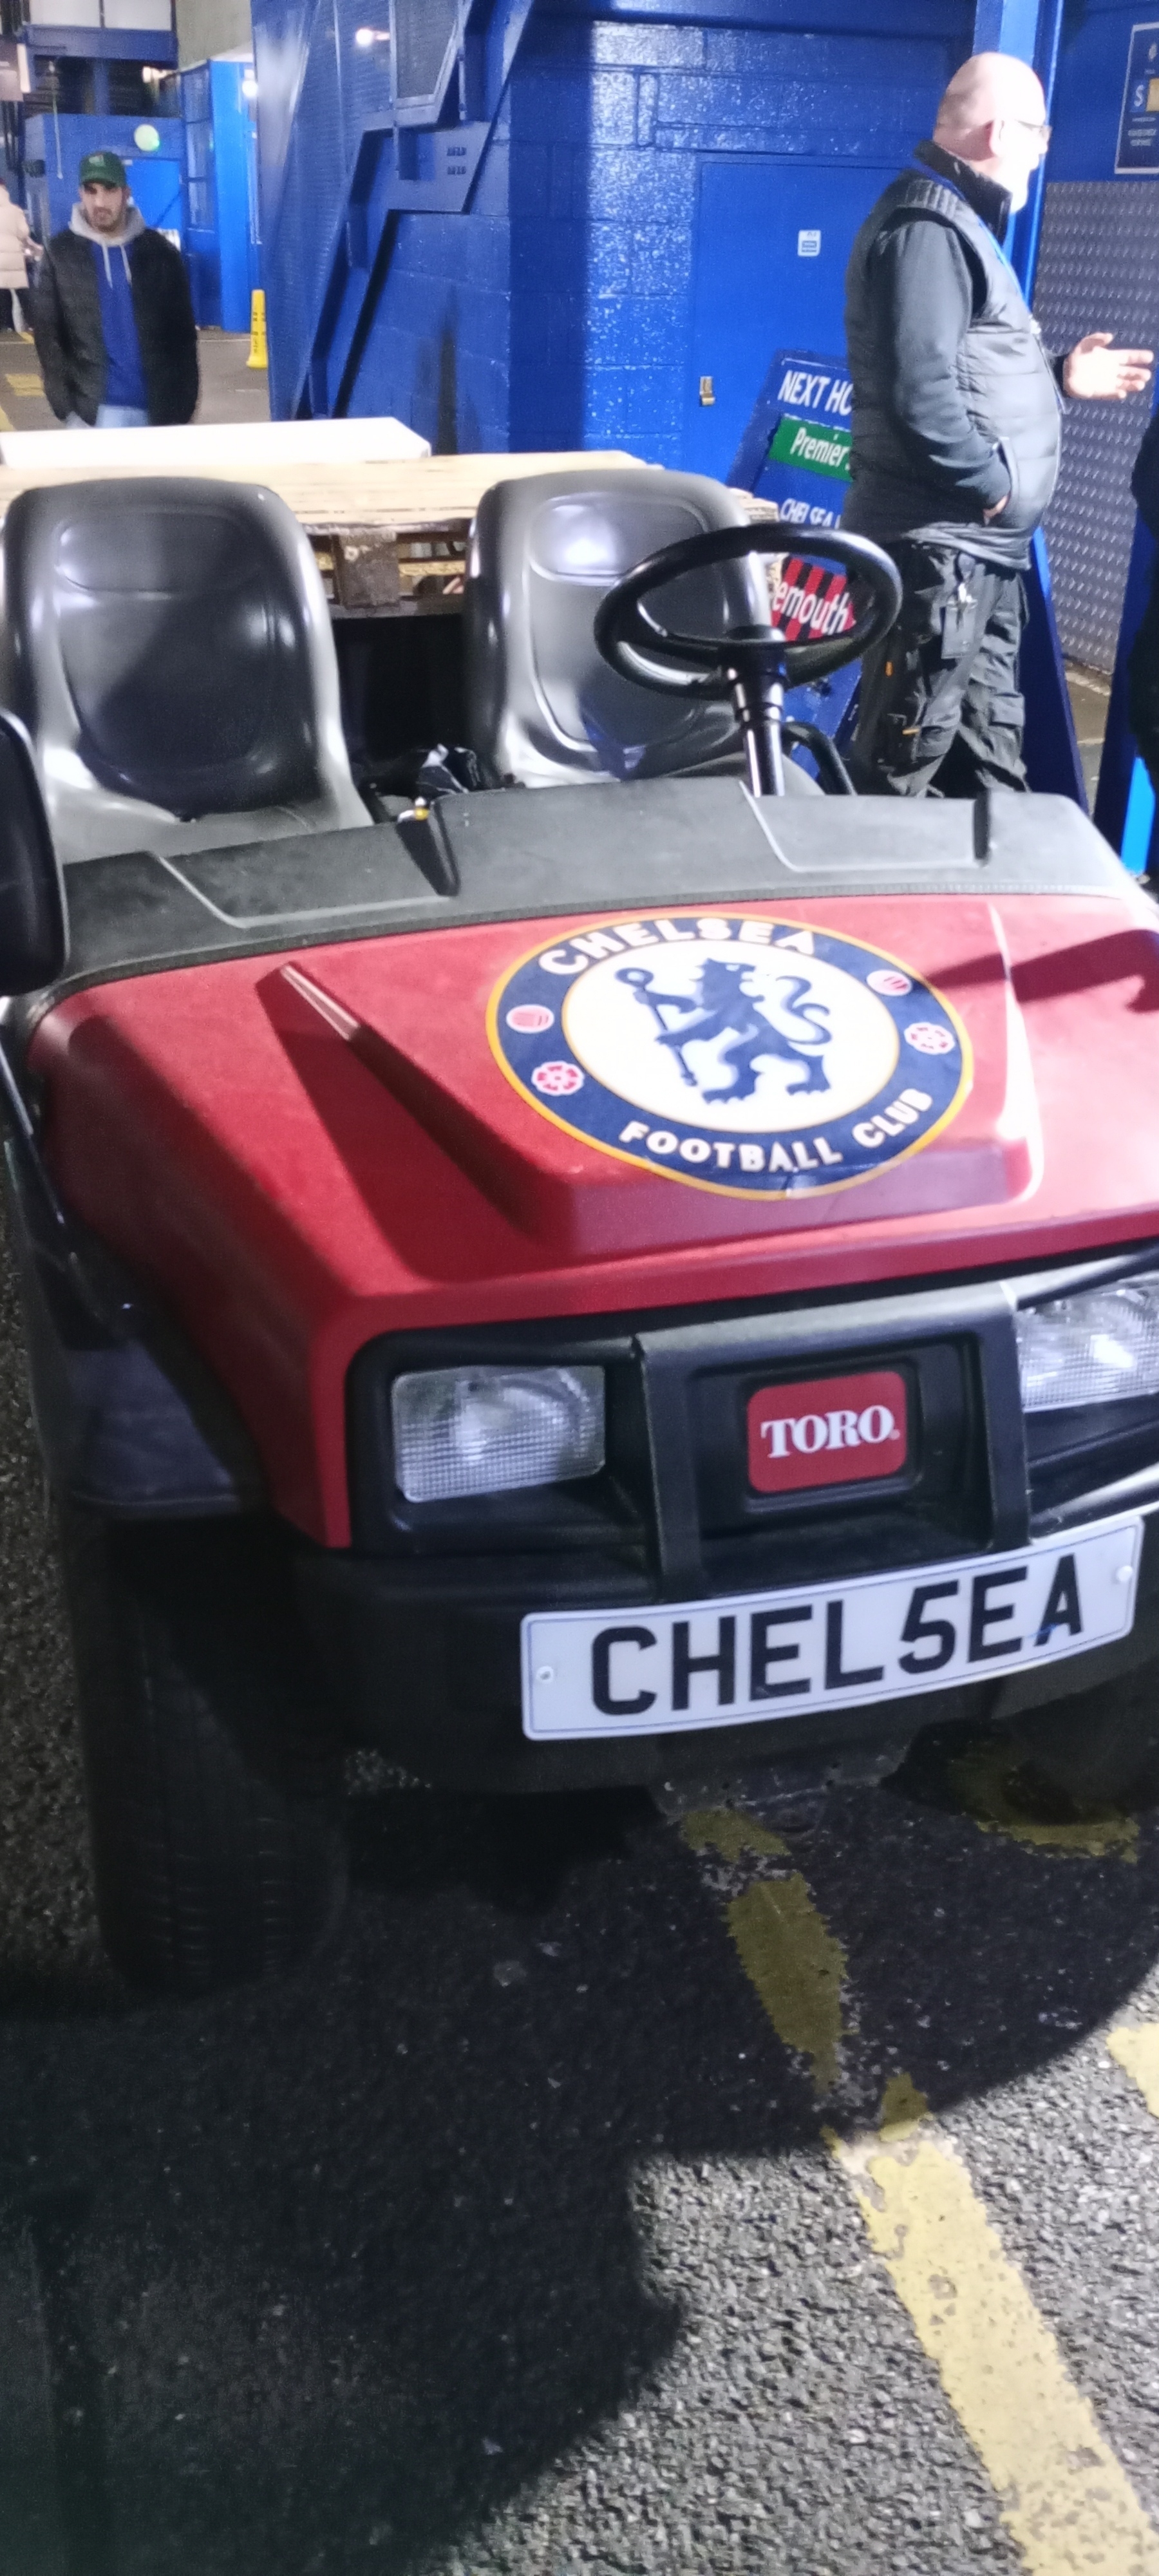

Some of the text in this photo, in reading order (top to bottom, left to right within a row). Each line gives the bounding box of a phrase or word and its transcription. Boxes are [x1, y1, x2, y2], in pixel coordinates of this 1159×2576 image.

[777, 369, 831, 410] NEXT
[789, 426, 851, 468] Premier
[539, 918, 816, 975] CHELSEA
[619, 1088, 933, 1173] FOOTBALL CLUB
